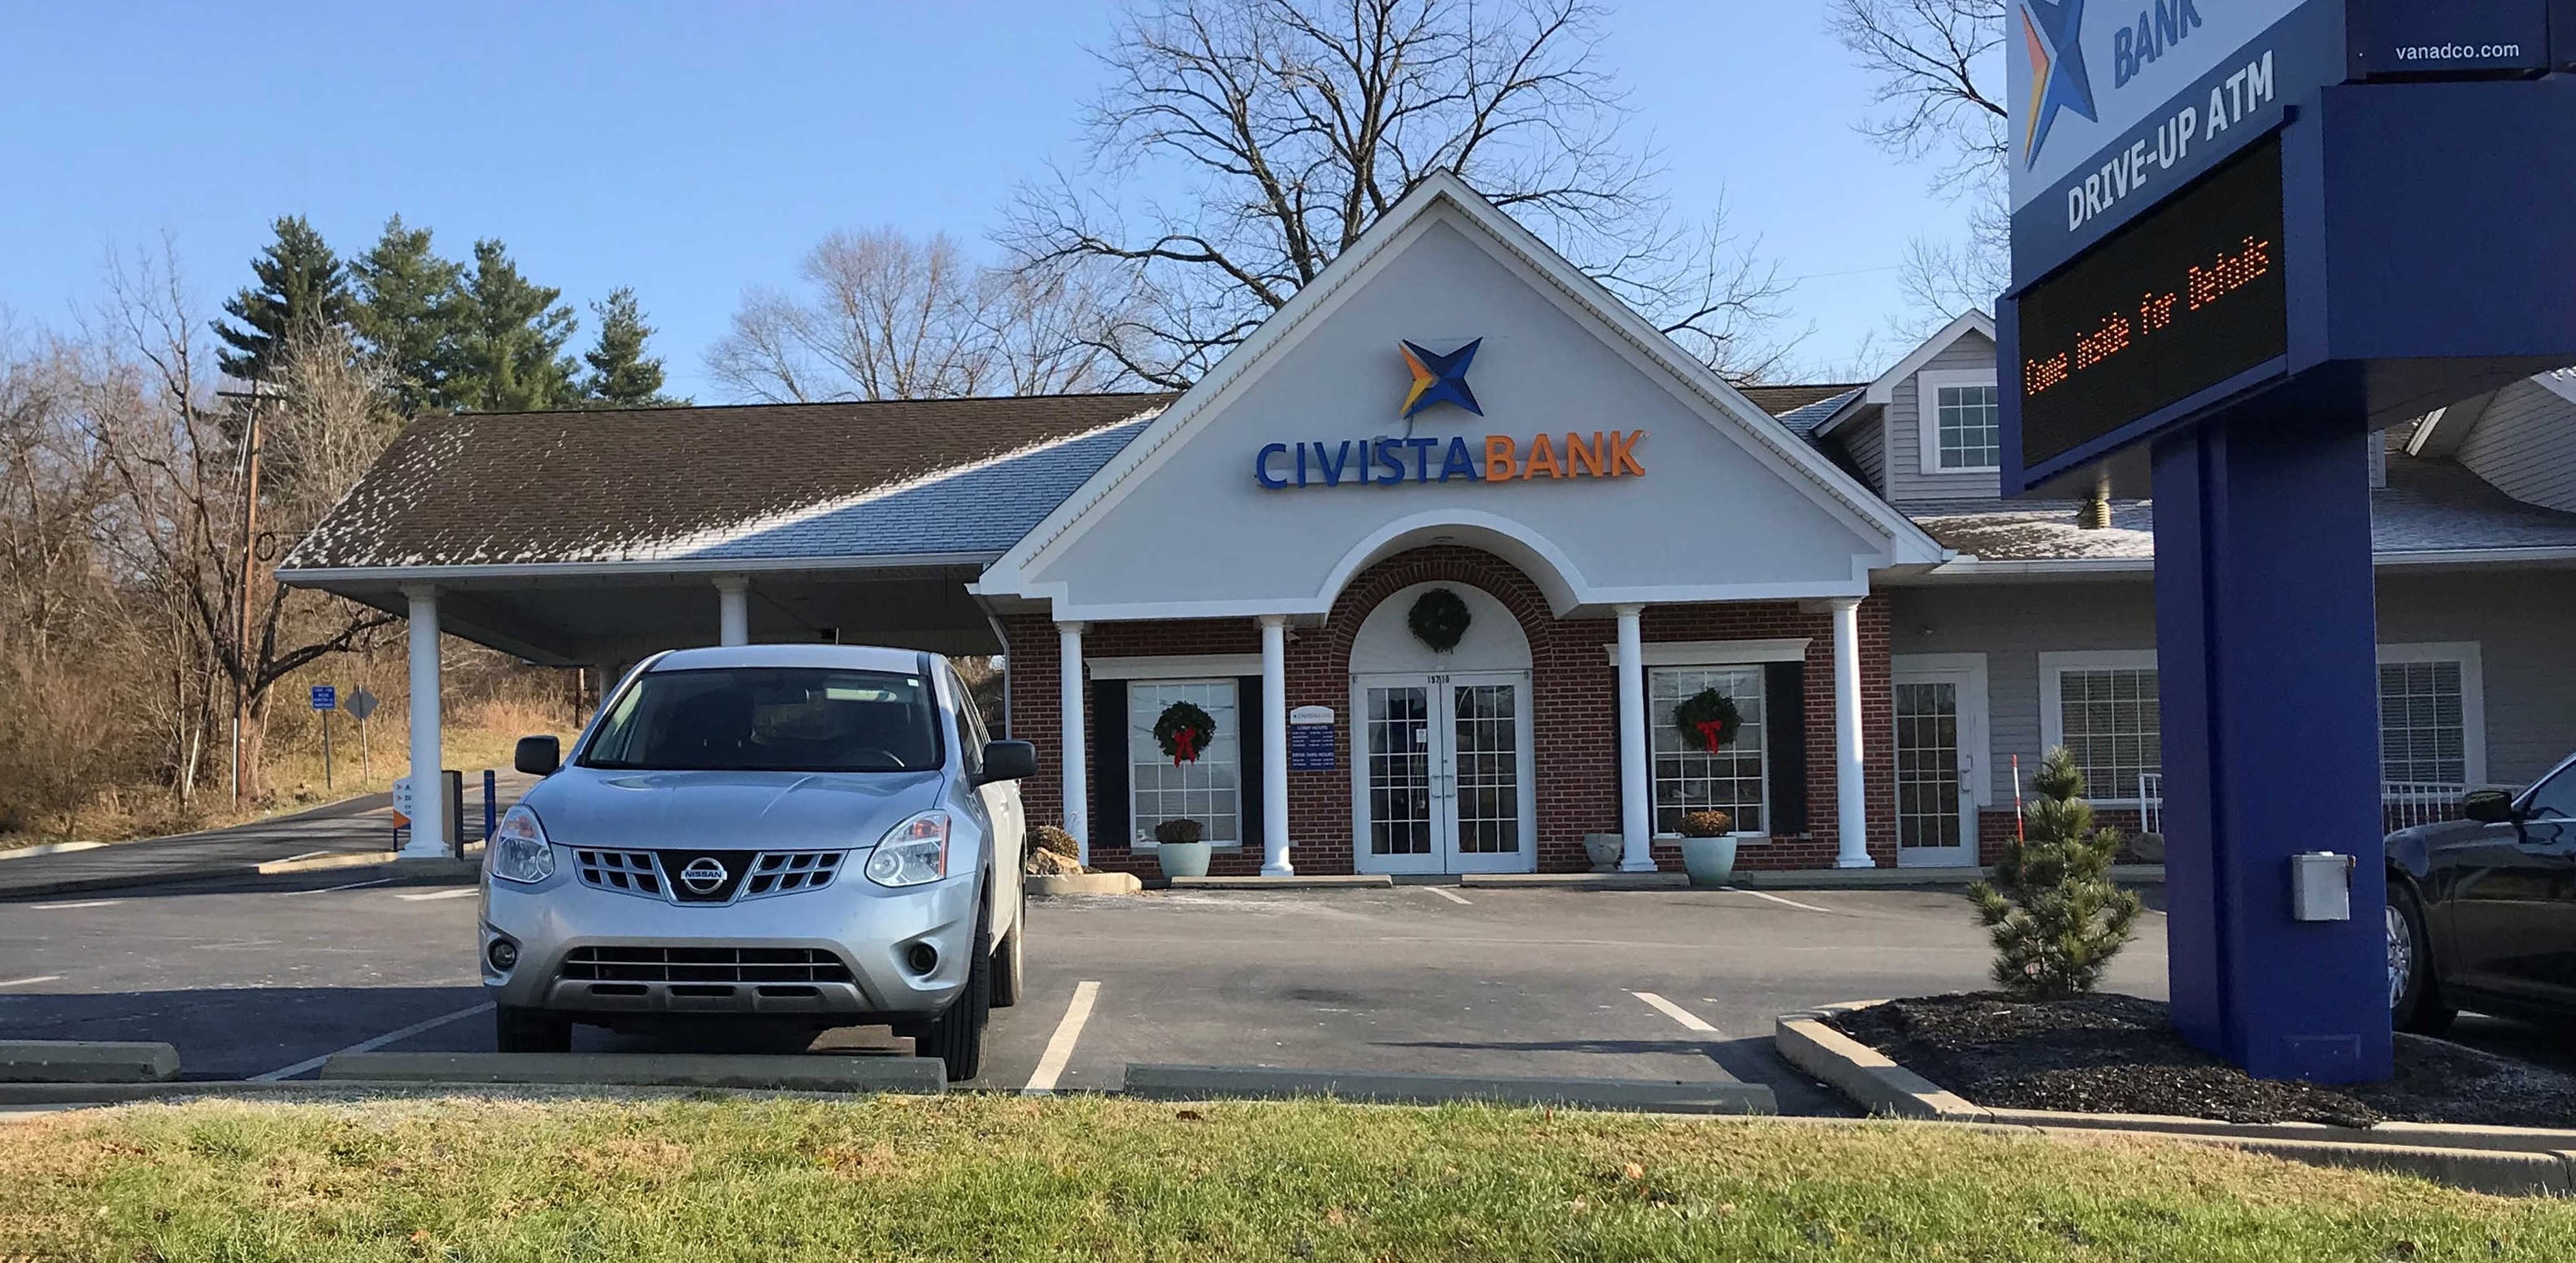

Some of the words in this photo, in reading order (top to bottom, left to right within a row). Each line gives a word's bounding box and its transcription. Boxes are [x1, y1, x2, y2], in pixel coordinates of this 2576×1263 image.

[2114, 0, 2202, 89] BANK
[2395, 42, 2520, 60] vanadco.com
[2068, 106, 2197, 232] DRIVE-UP
[2205, 50, 2274, 142] ATM
[2026, 352, 2068, 395] Come
[2076, 311, 2130, 369] inside
[2140, 292, 2177, 334] for
[2189, 235, 2269, 311] Details
